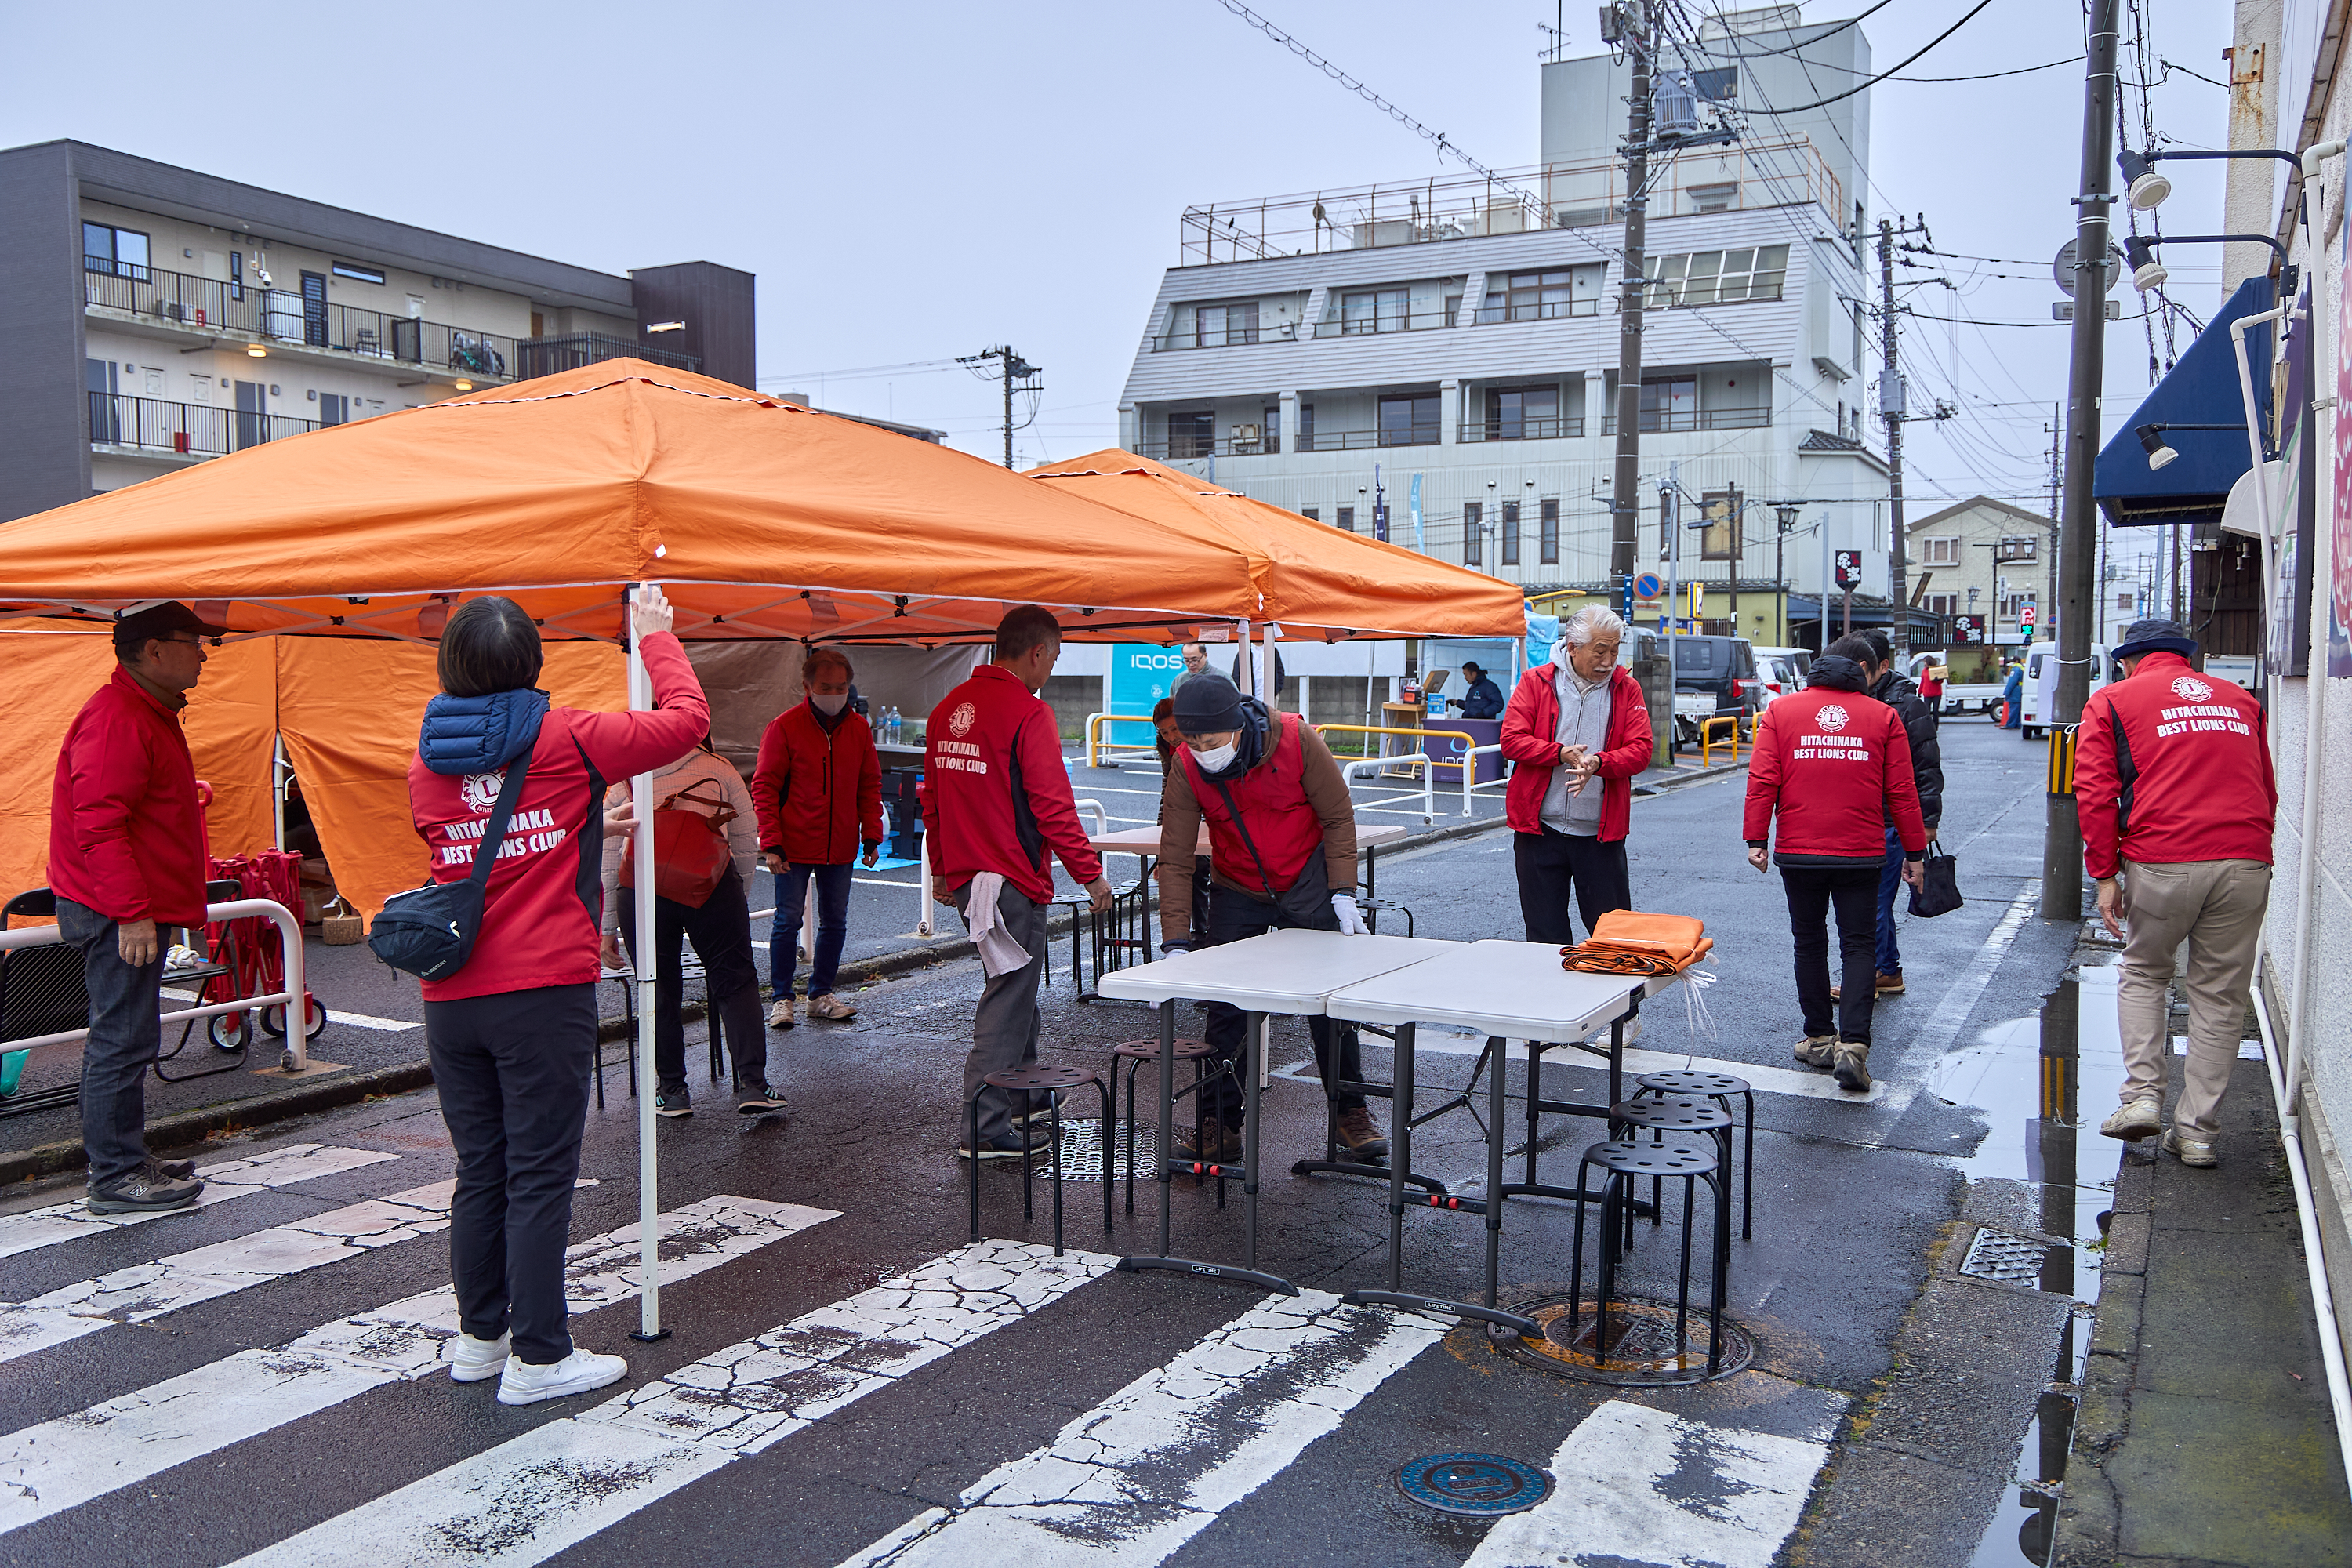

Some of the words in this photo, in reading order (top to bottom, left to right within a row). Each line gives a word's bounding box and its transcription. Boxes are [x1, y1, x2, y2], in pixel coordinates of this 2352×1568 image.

[2022, 608, 2034, 625] P
[1131, 654, 1183, 671] IQOS
[2187, 684, 2200, 692] L
[960, 713, 966, 725] L
[1828, 713, 1837, 722] L
[2161, 705, 2240, 720] HITACHINAKA
[2156, 720, 2187, 737] BEST
[2190, 719, 2227, 731] LIONS
[2227, 720, 2250, 736] CLUB
[1800, 735, 1864, 748] HITACHINAKA
[1794, 749, 1815, 760] BEST
[1817, 748, 1846, 760] LIONS
[1847, 750, 1869, 761] CLUB
[966, 759, 987, 775] CLUB
[480, 779, 499, 799] L
[445, 808, 554, 840] HITACNAKA
[441, 844, 474, 865] BEST
[477, 837, 527, 859] ONS
[1428, 1302, 1452, 1311] LIFETIME
